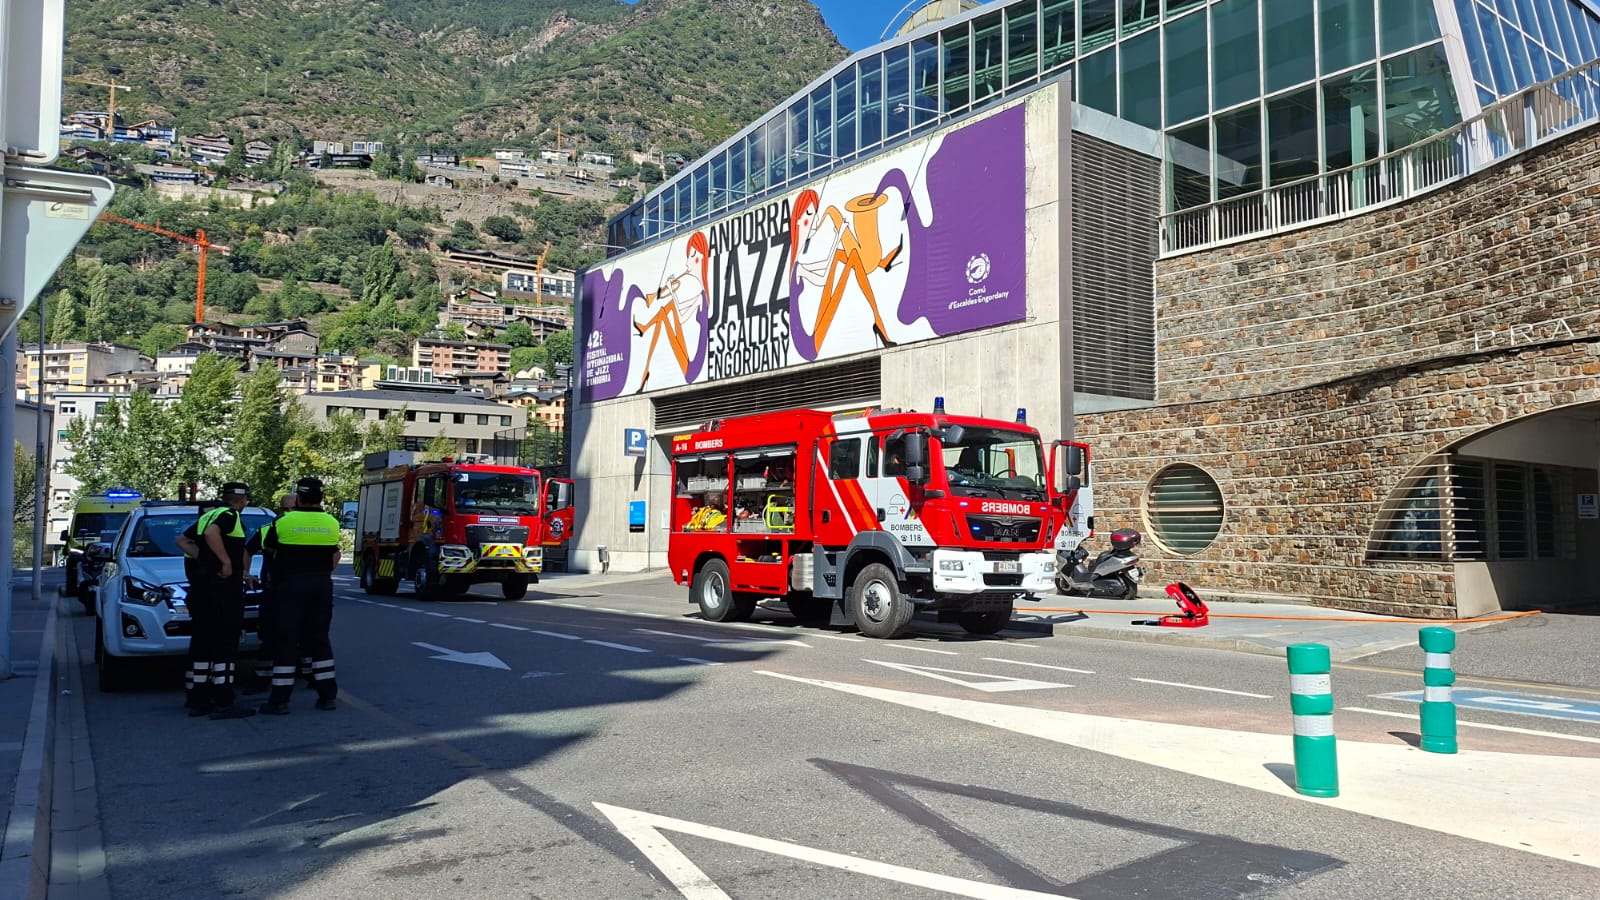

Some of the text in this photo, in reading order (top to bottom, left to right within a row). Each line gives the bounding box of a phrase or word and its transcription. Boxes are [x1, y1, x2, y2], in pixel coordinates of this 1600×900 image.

[708, 197, 791, 258] ANDORRA
[708, 231, 791, 330] JAZZ
[968, 285, 987, 296] Comú
[708, 308, 790, 358] ESCALDES
[708, 337, 790, 382] ENGORDANY
[586, 365, 610, 379] DE JAZZ
[631, 431, 642, 446] P
[695, 438, 724, 450] BOMBERS
[890, 523, 923, 532] BOMBERS
[909, 534, 922, 542] 118
